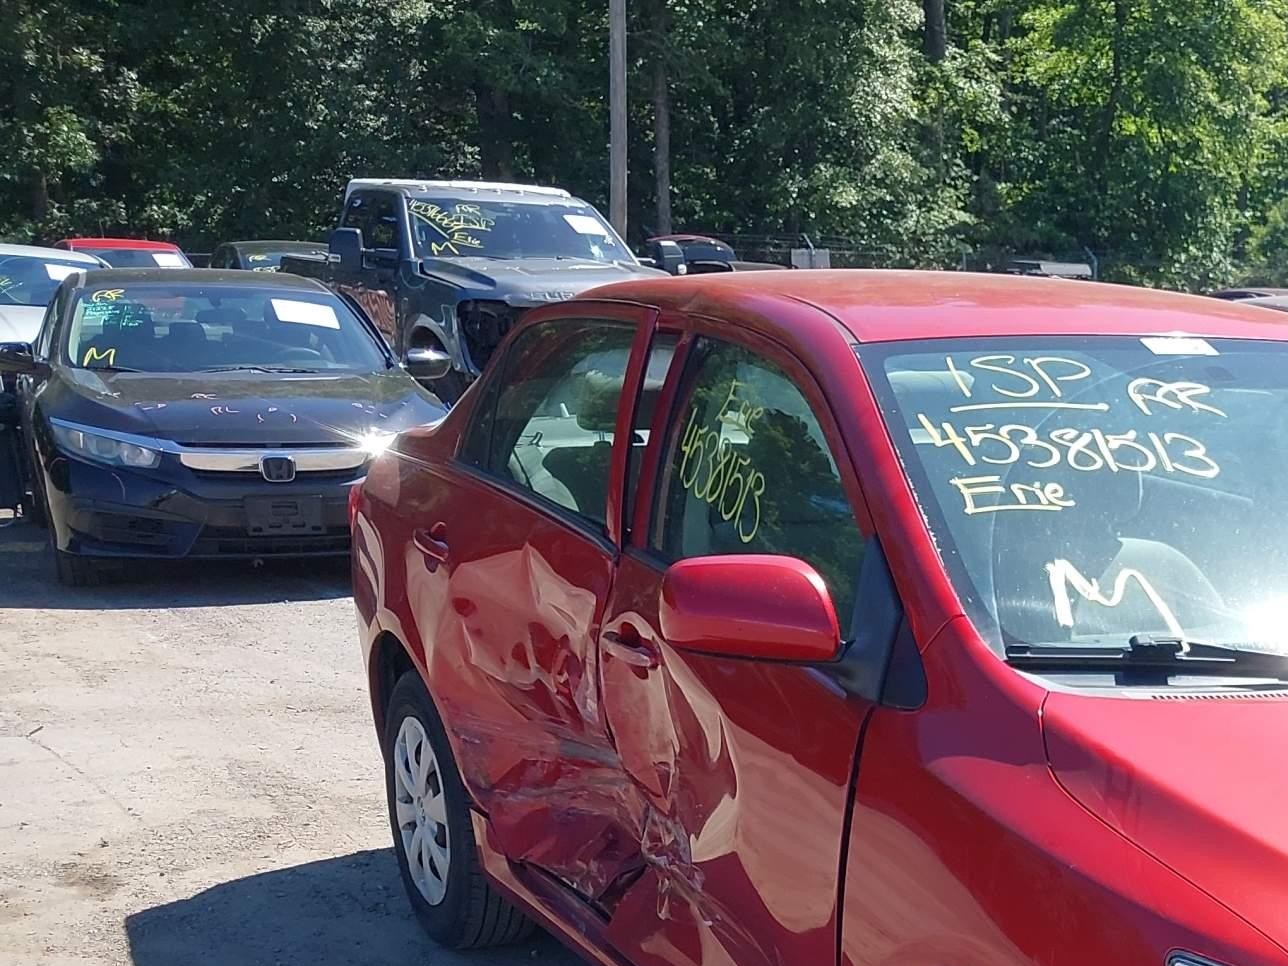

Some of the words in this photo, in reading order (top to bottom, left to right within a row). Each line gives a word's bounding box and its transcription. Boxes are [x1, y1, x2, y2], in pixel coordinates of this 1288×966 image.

[431, 241, 460, 255] M
[83, 347, 116, 367] M
[917, 413, 1220, 478] 45381513
[949, 475, 1076, 515] Erie
[1043, 558, 1191, 657] M
